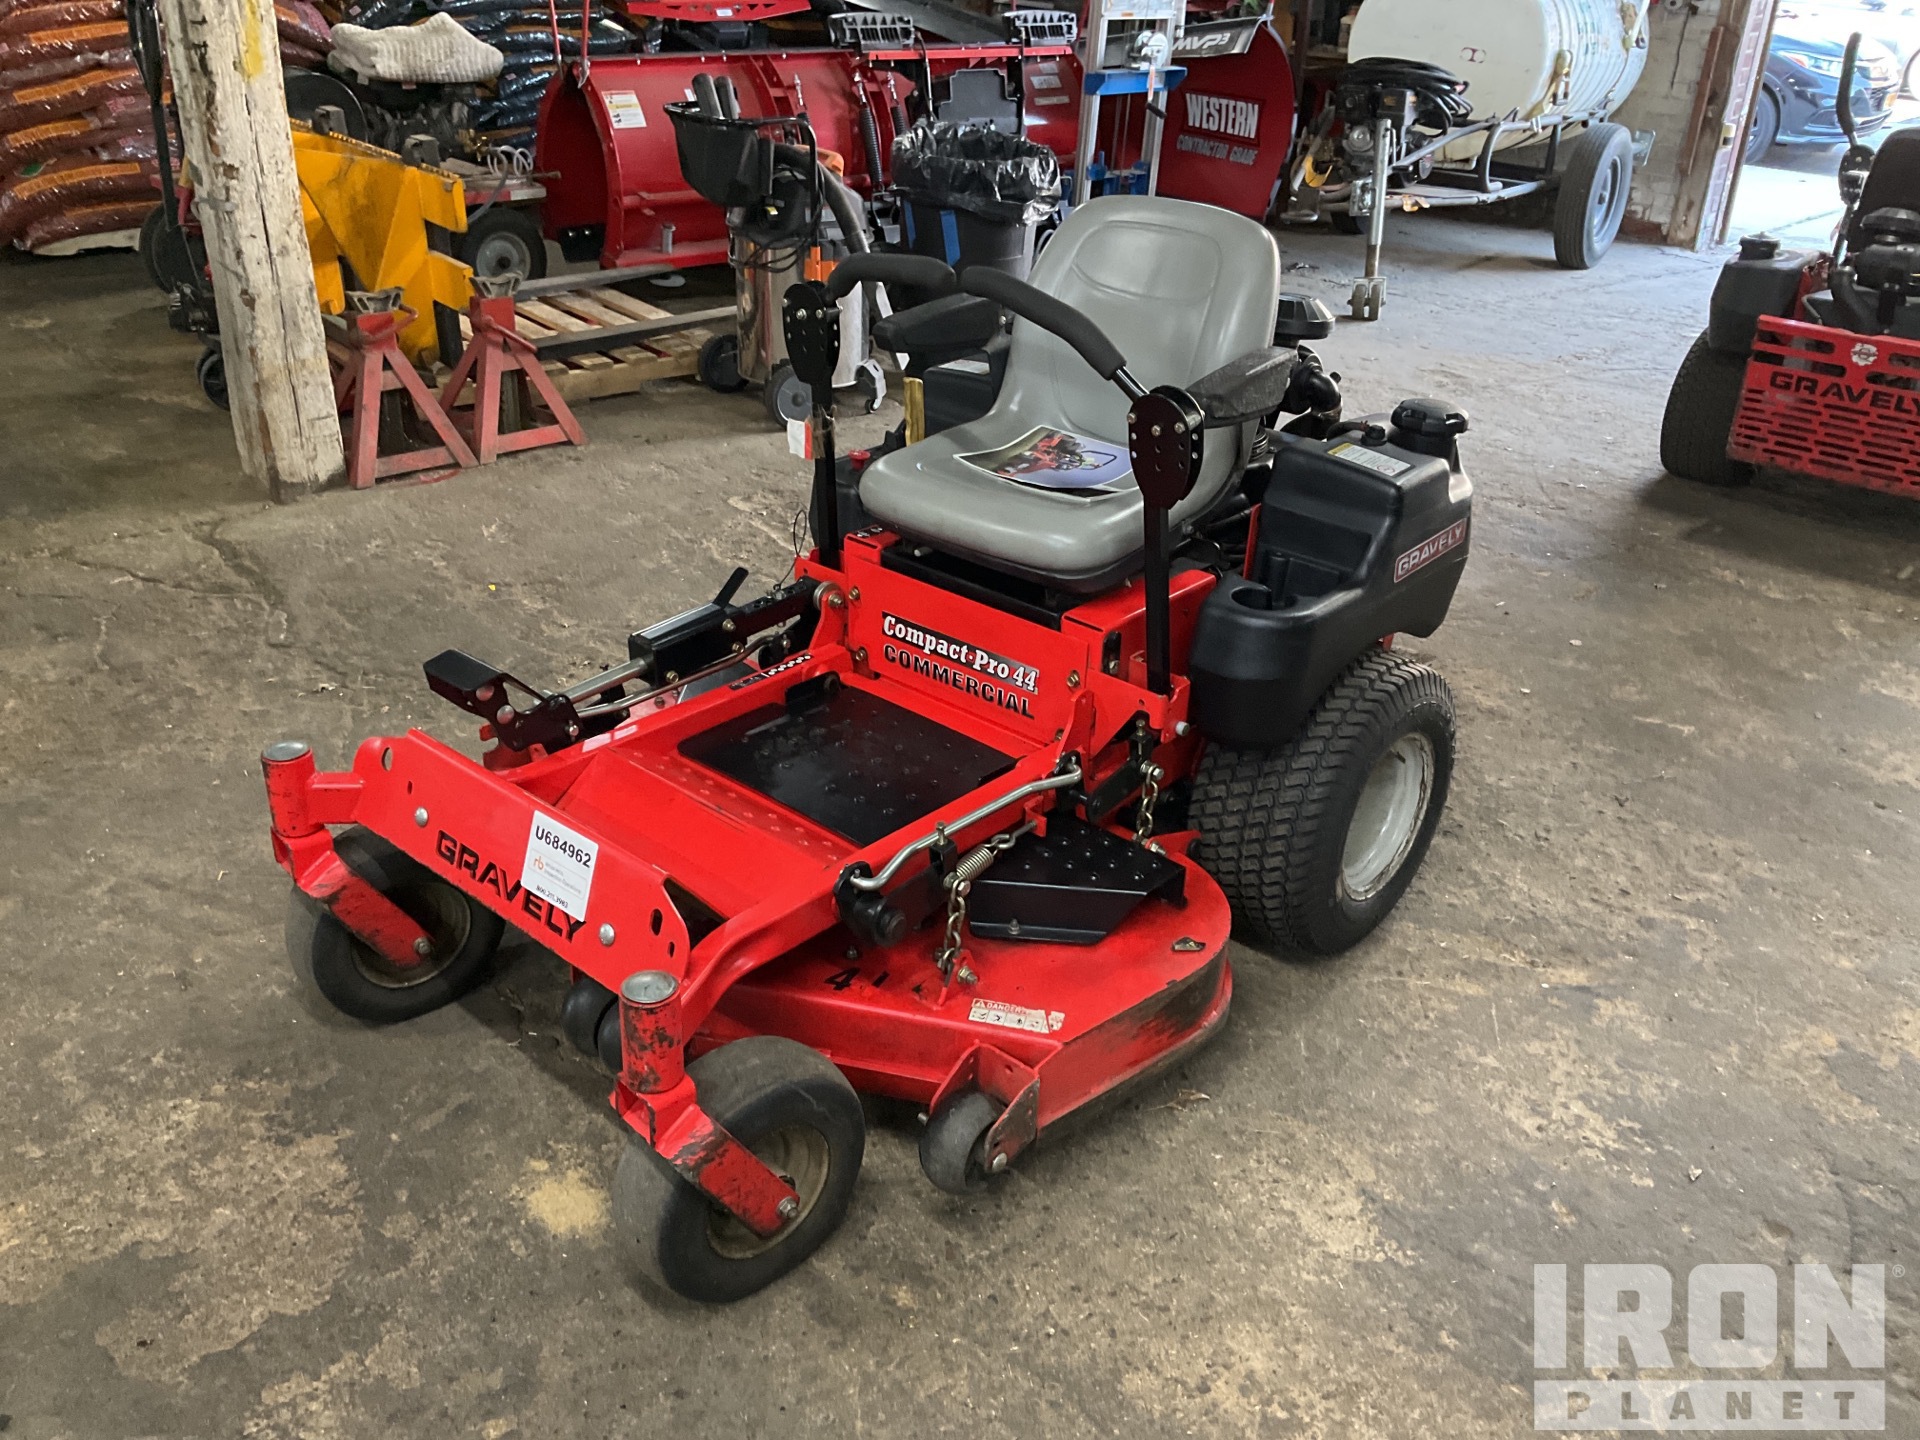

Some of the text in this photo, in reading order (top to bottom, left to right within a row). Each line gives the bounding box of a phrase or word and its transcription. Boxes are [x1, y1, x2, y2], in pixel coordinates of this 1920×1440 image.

[1185, 92, 1259, 139] WESTERN
[1176, 134, 1258, 166] CONTRACTOR GRADE
[1399, 525, 1464, 576] GRAVELY
[883, 643, 1035, 720] COMMERCIAL
[1012, 665, 1038, 693] 44
[535, 825, 592, 869] U684962
[436, 829, 587, 943] GRAVELY
